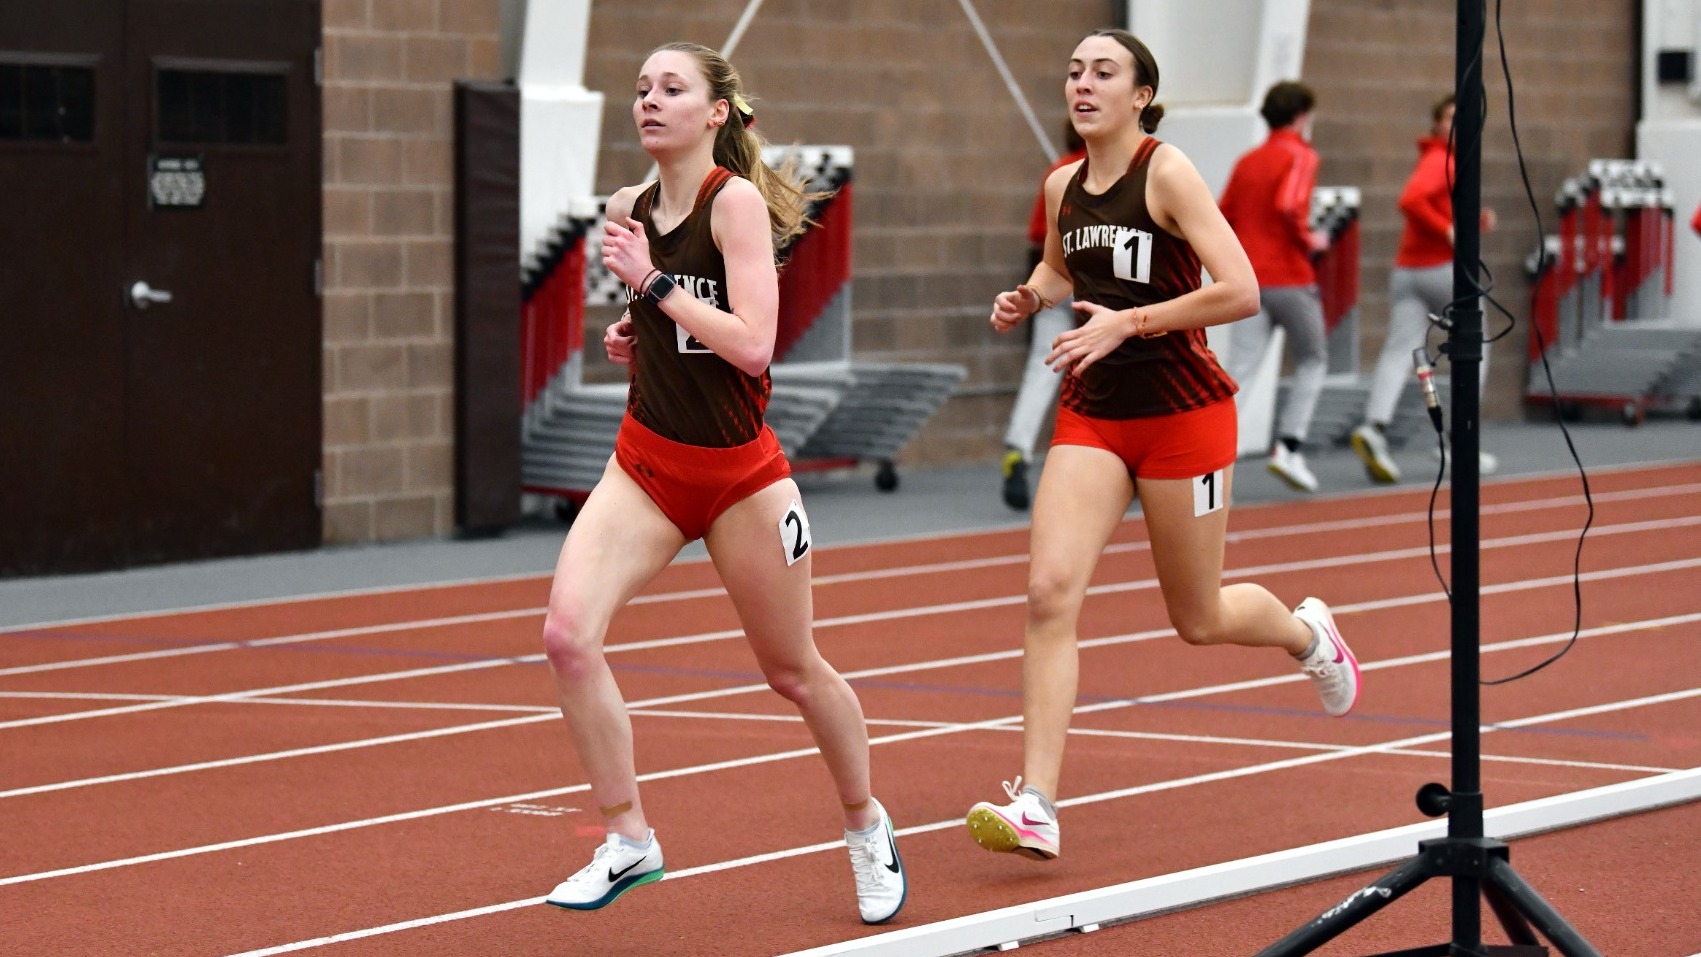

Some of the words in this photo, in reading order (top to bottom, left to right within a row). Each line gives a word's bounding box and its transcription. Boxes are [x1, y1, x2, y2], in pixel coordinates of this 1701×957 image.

[1063, 231, 1074, 258] ST.
[1076, 225, 1140, 251] LAWRE
[1123, 235, 1140, 279] 1
[1201, 471, 1215, 510] 1
[785, 510, 808, 560] 2
